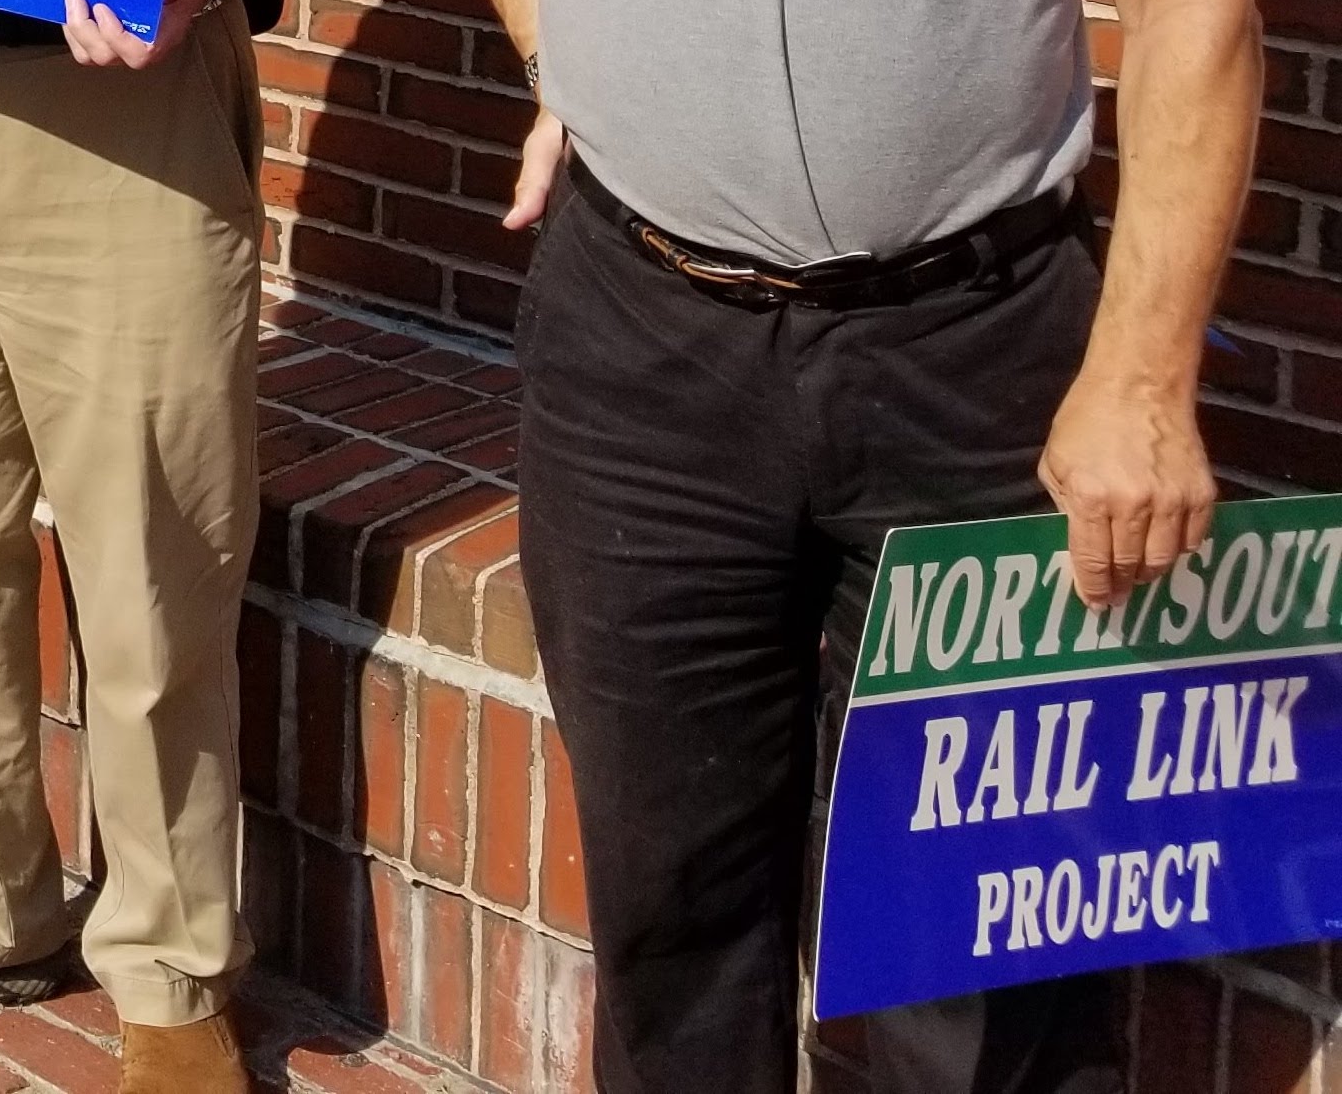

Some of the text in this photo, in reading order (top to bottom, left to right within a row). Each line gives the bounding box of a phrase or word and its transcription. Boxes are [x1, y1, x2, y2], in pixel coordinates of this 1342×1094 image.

[868, 526, 1342, 677] NORT/SOUT
[909, 675, 1309, 832] RAIL LINK
[972, 840, 1220, 957] PROJECT
